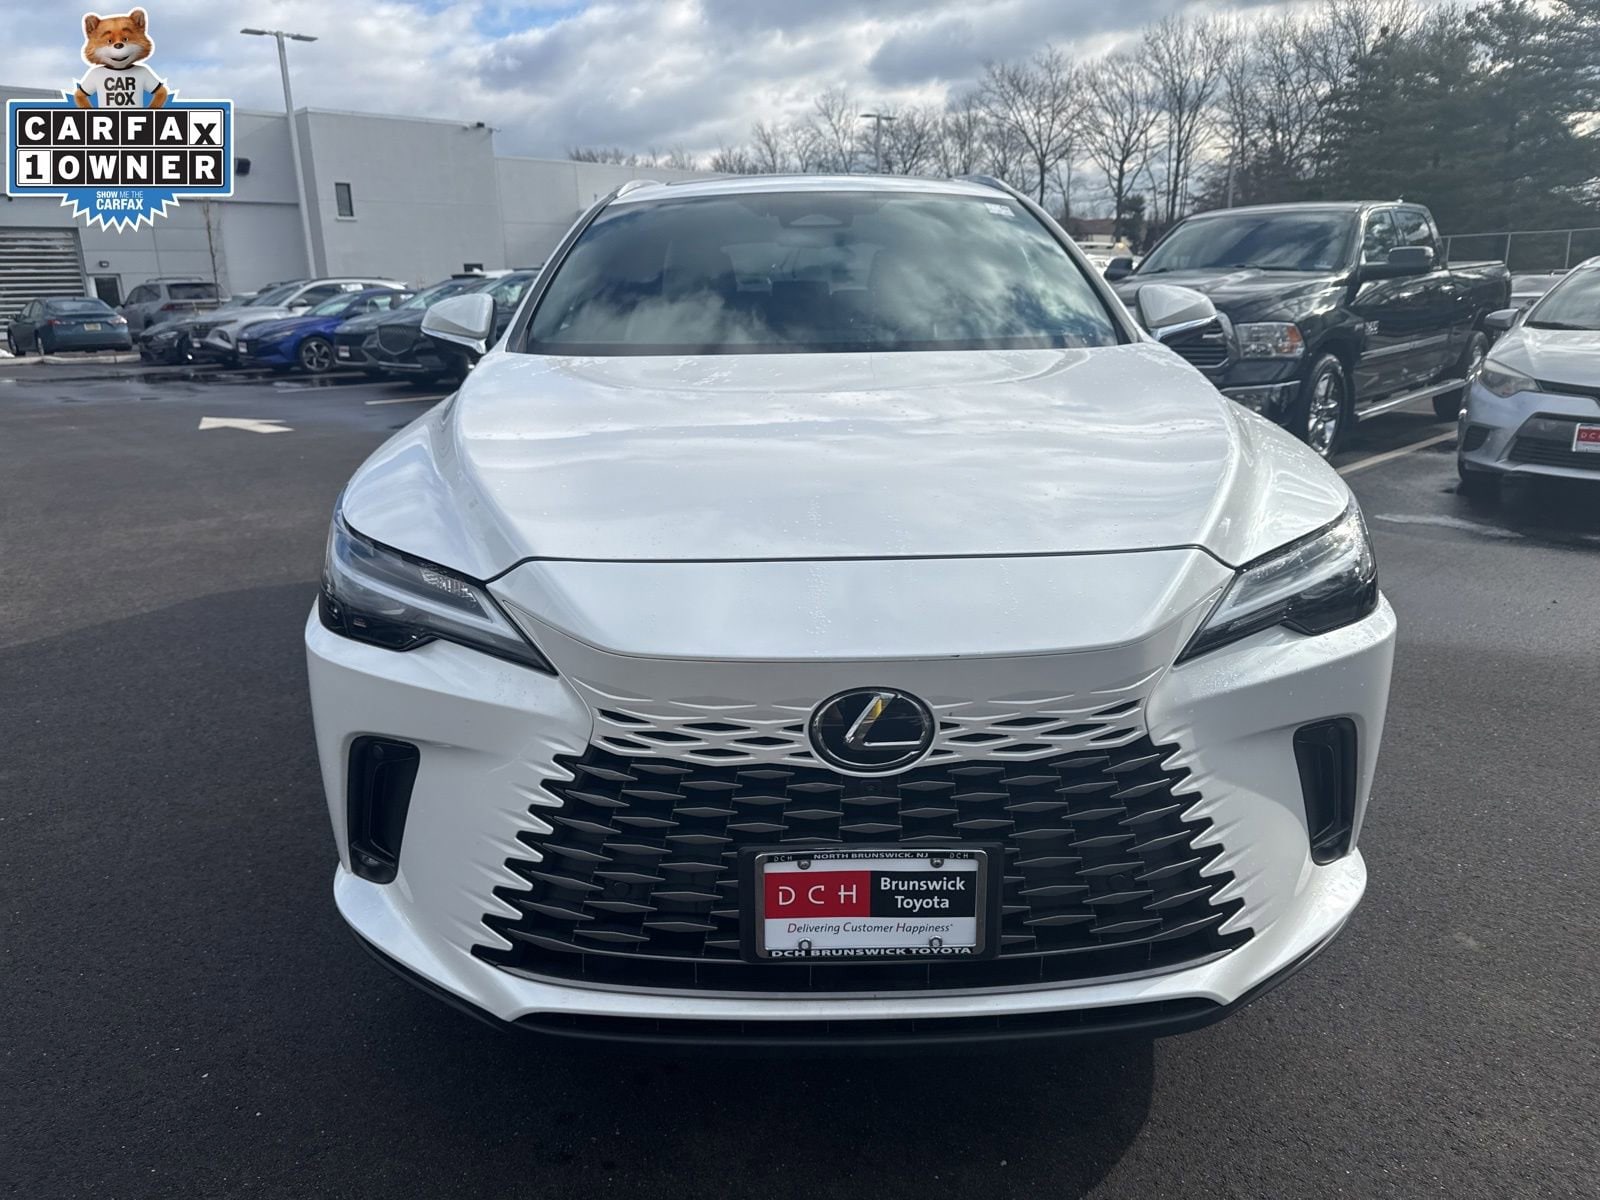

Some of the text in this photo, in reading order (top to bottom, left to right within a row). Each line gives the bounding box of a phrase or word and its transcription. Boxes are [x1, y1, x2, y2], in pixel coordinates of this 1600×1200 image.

[880, 876, 966, 891] Brunswick
[895, 895, 950, 913] Toyota
[787, 922, 841, 935] Delivering
[843, 921, 894, 933] Customer
[810, 947, 906, 957] BRUNSWICK
[909, 947, 972, 955] TOYOTA
